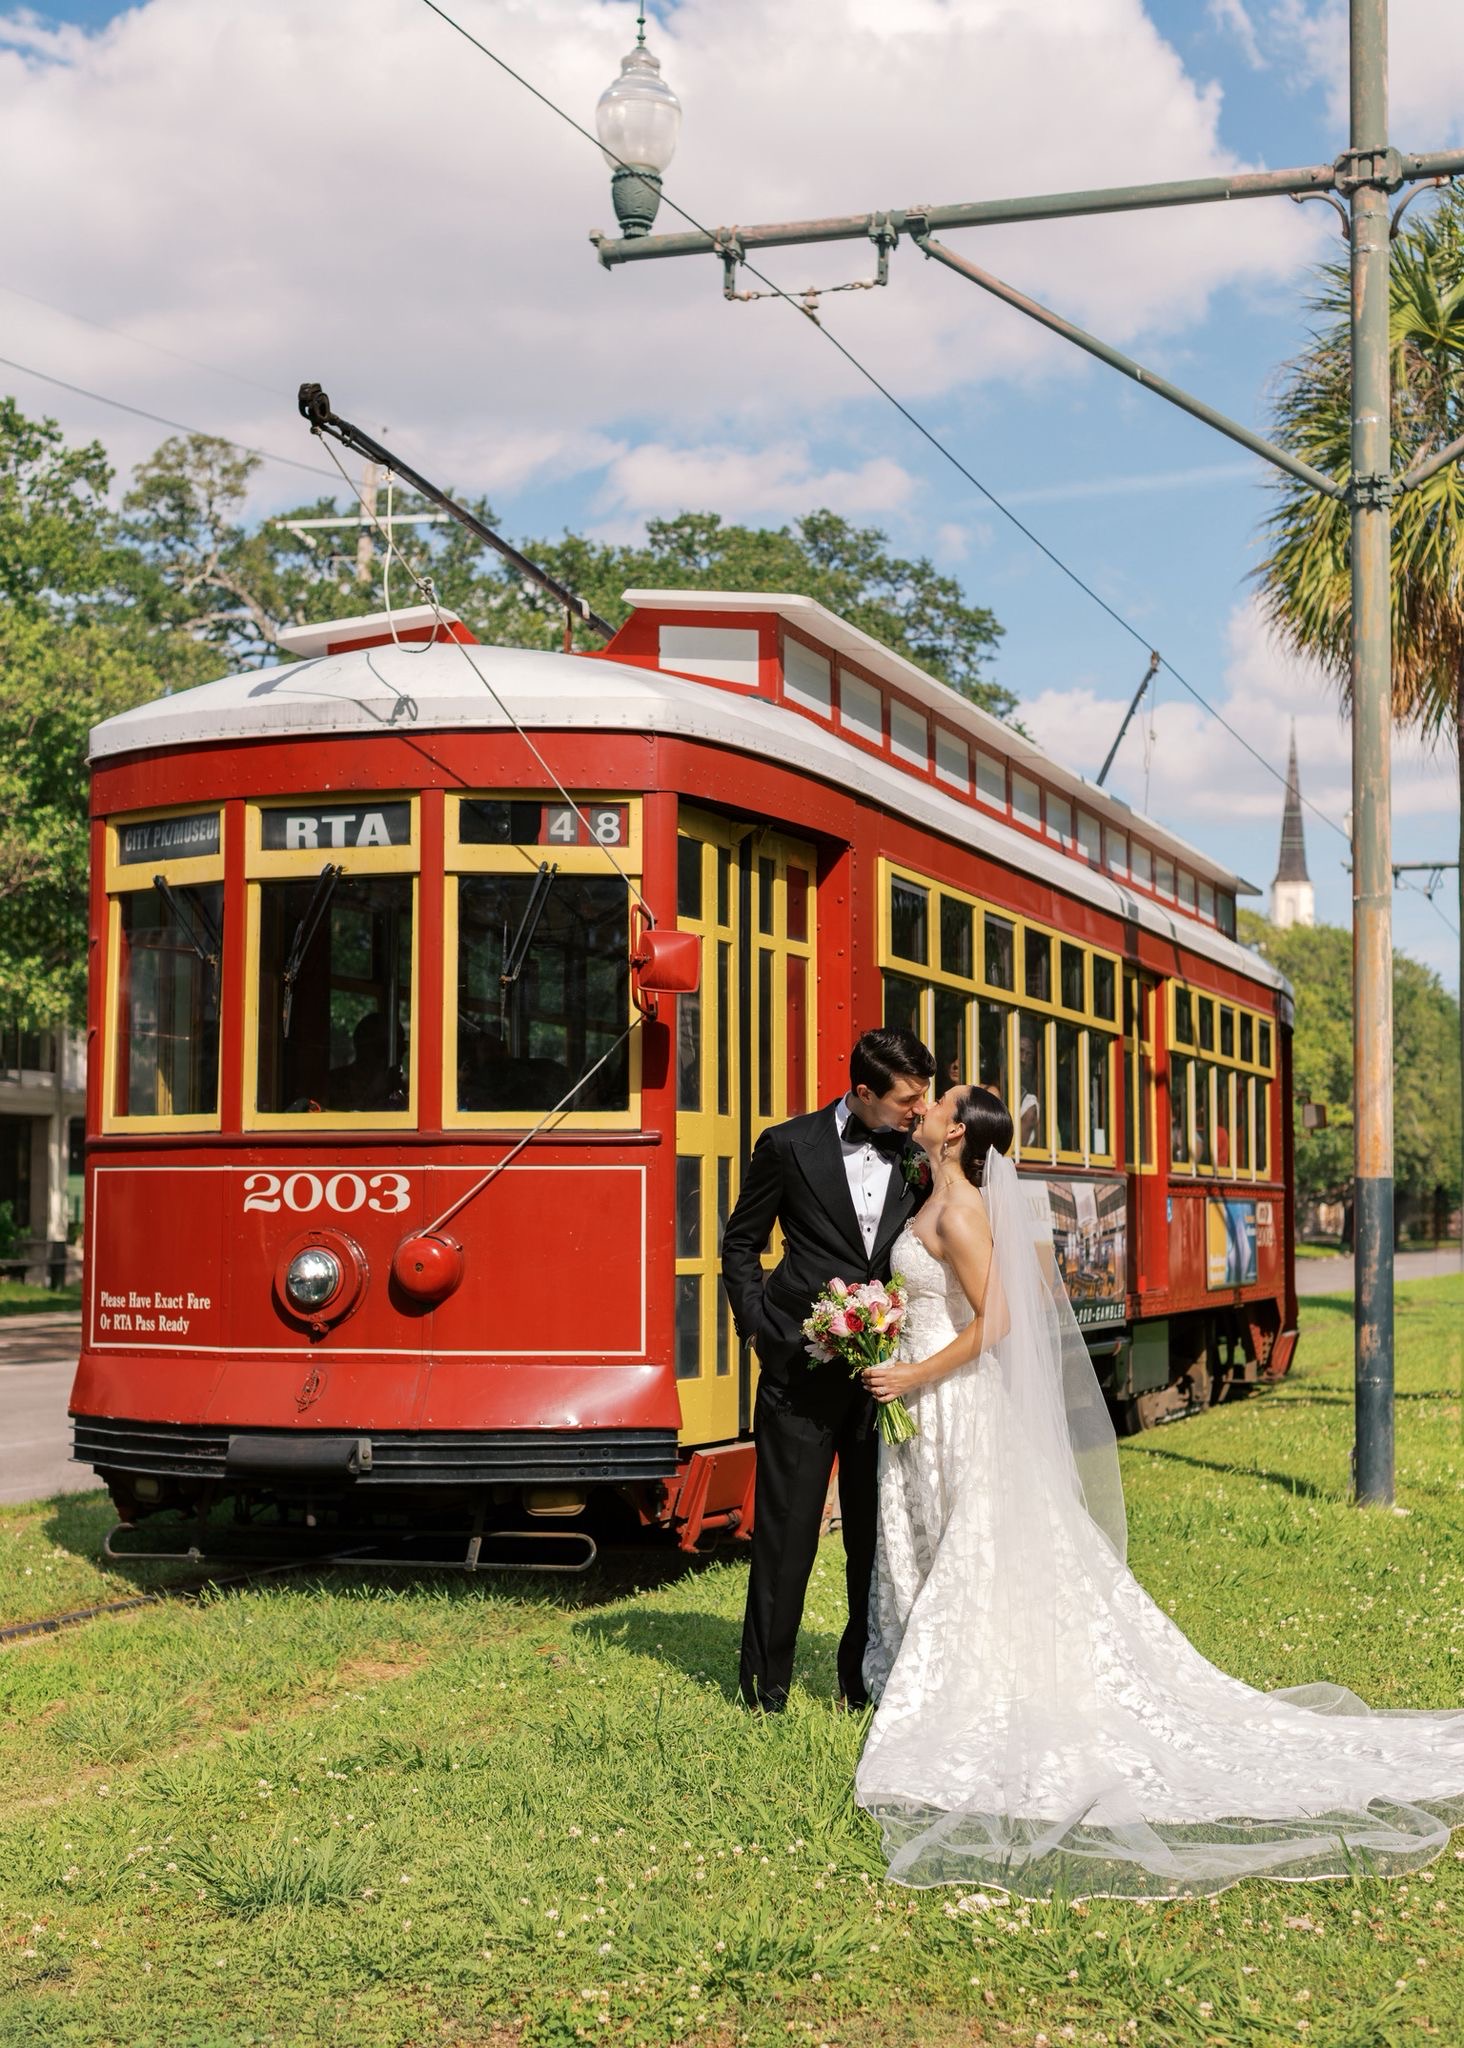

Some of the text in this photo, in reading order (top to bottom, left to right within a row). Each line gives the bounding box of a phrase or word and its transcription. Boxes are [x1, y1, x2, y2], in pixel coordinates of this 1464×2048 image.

[125, 818, 219, 852] CITY PK/MUSEU
[286, 813, 392, 849] RTA
[244, 1173, 411, 1213] 2003
[100, 1291, 211, 1310] Please Have Exact Fare
[100, 1313, 190, 1335] Or RTA Pass Ready
